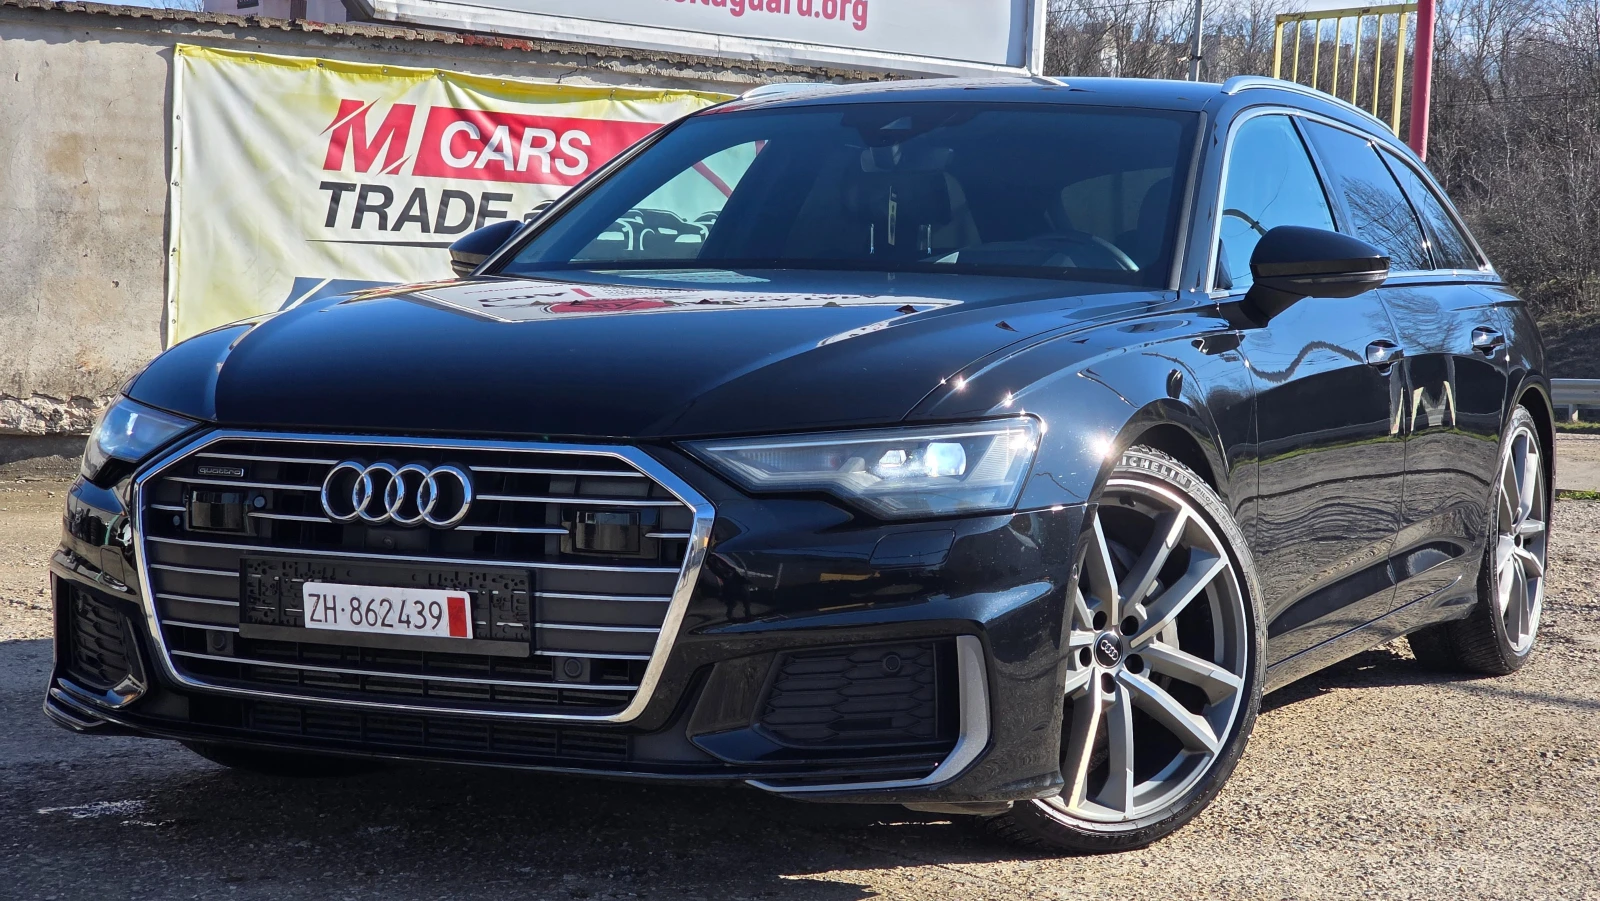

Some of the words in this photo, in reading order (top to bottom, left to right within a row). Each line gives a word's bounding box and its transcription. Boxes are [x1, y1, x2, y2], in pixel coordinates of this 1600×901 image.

[319, 97, 416, 176] M
[440, 120, 592, 177] CARS
[319, 180, 514, 235] TRADE
[199, 466, 242, 476] quattro
[1115, 456, 1190, 486] ICHELIN
